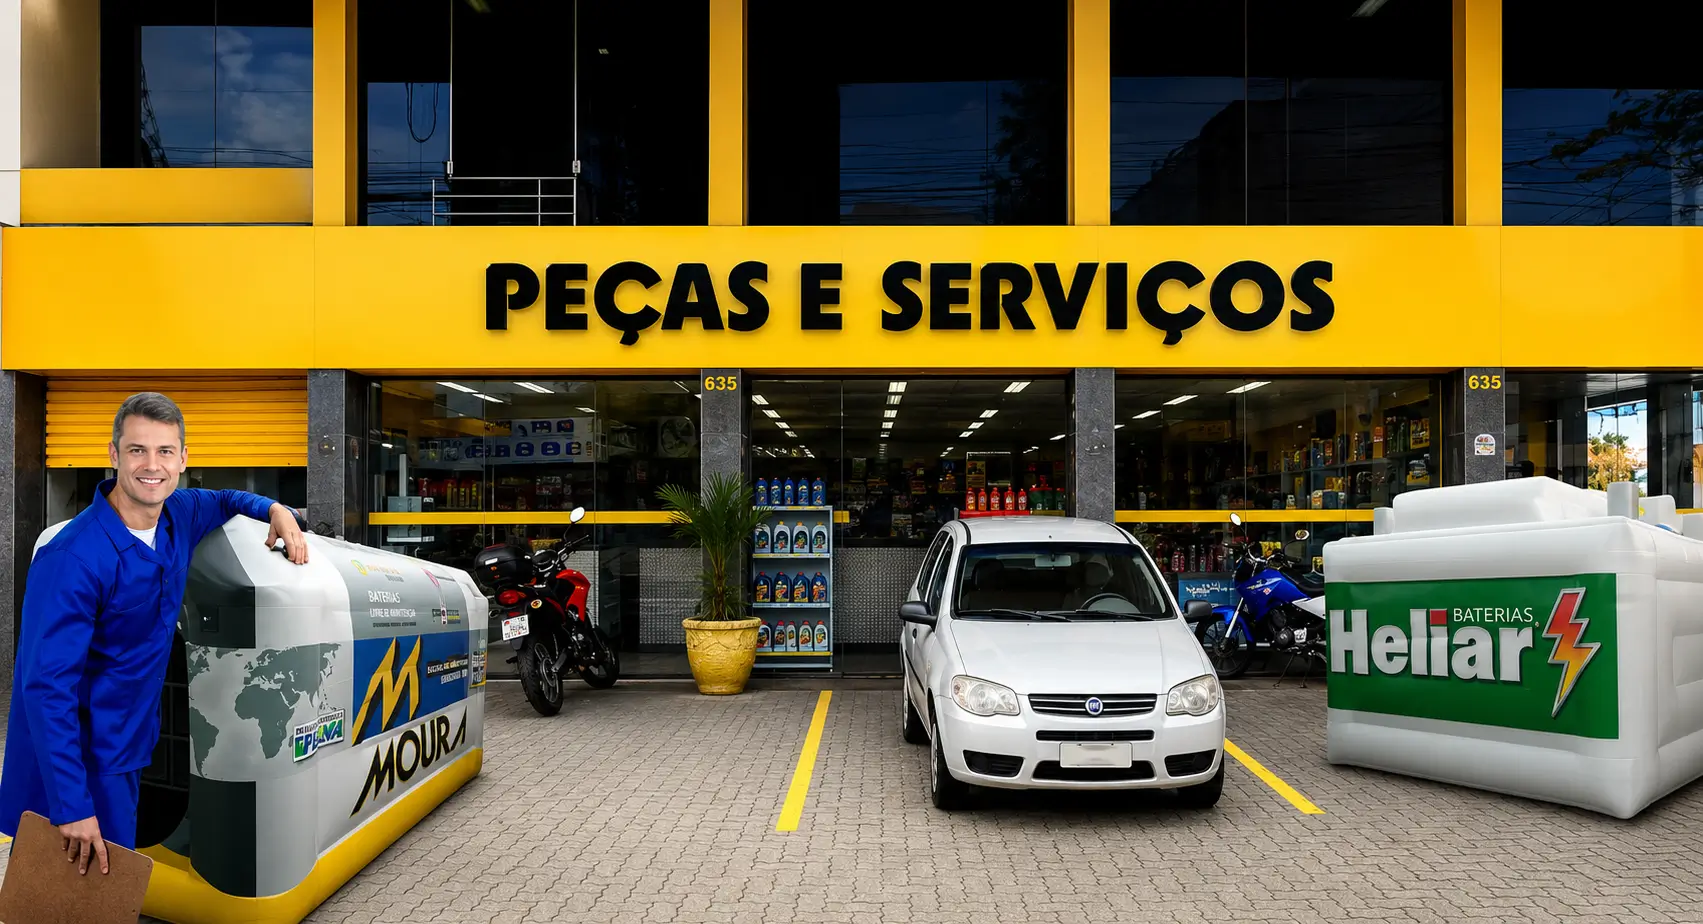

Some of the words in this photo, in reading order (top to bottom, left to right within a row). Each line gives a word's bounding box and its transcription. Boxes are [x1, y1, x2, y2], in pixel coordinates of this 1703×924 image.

[485, 261, 770, 346] PEÇAS
[800, 263, 843, 331] E
[881, 260, 1335, 346] SERVIÇOS
[704, 376, 737, 391] 635
[1468, 375, 1502, 390] 635
[1453, 607, 1533, 623] BATERIAS
[1329, 608, 1533, 682] Heliar
[349, 705, 467, 819] MOURA
